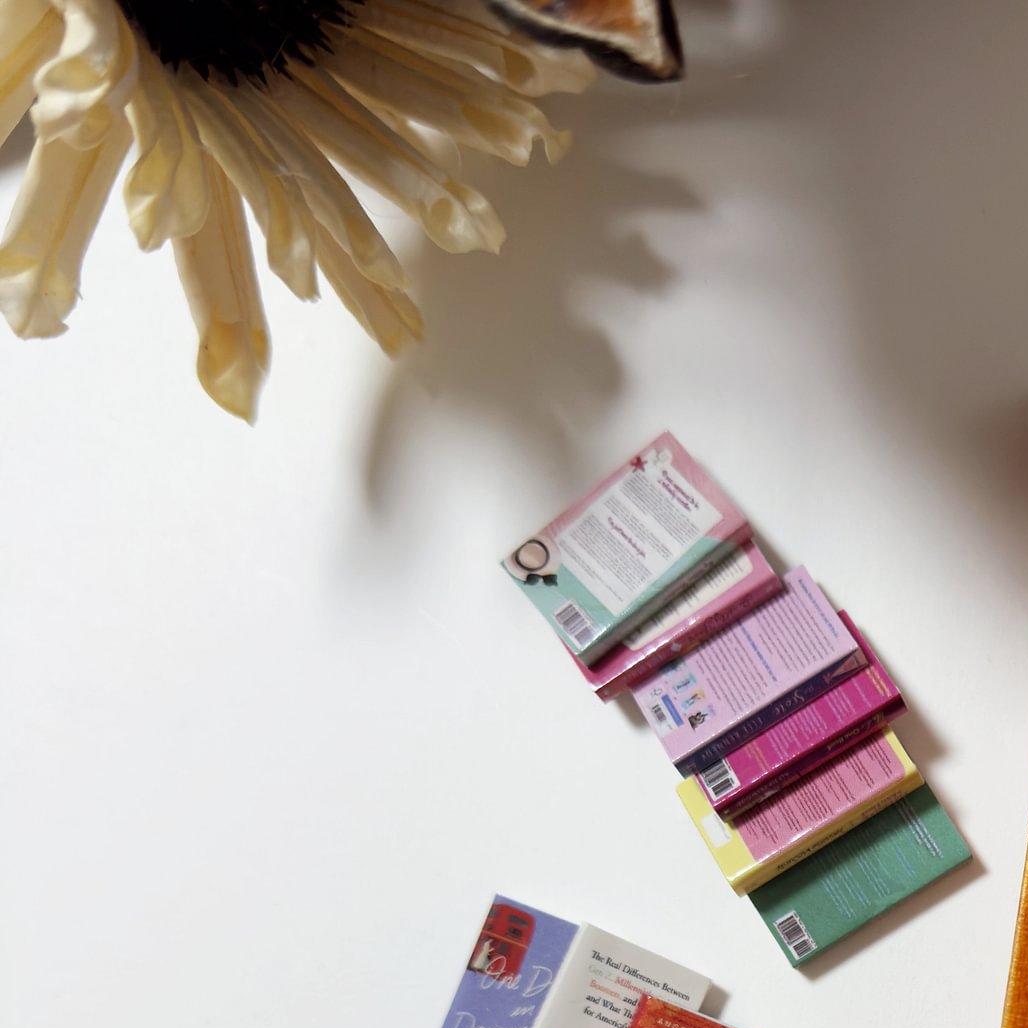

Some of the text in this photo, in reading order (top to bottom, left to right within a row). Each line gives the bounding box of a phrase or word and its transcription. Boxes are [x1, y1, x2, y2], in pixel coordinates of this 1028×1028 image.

[590, 950, 691, 1001] The Real Differences Between
[585, 992, 621, 1013] and What
[622, 995, 637, 1006] and
[583, 1006, 595, 1016] for
